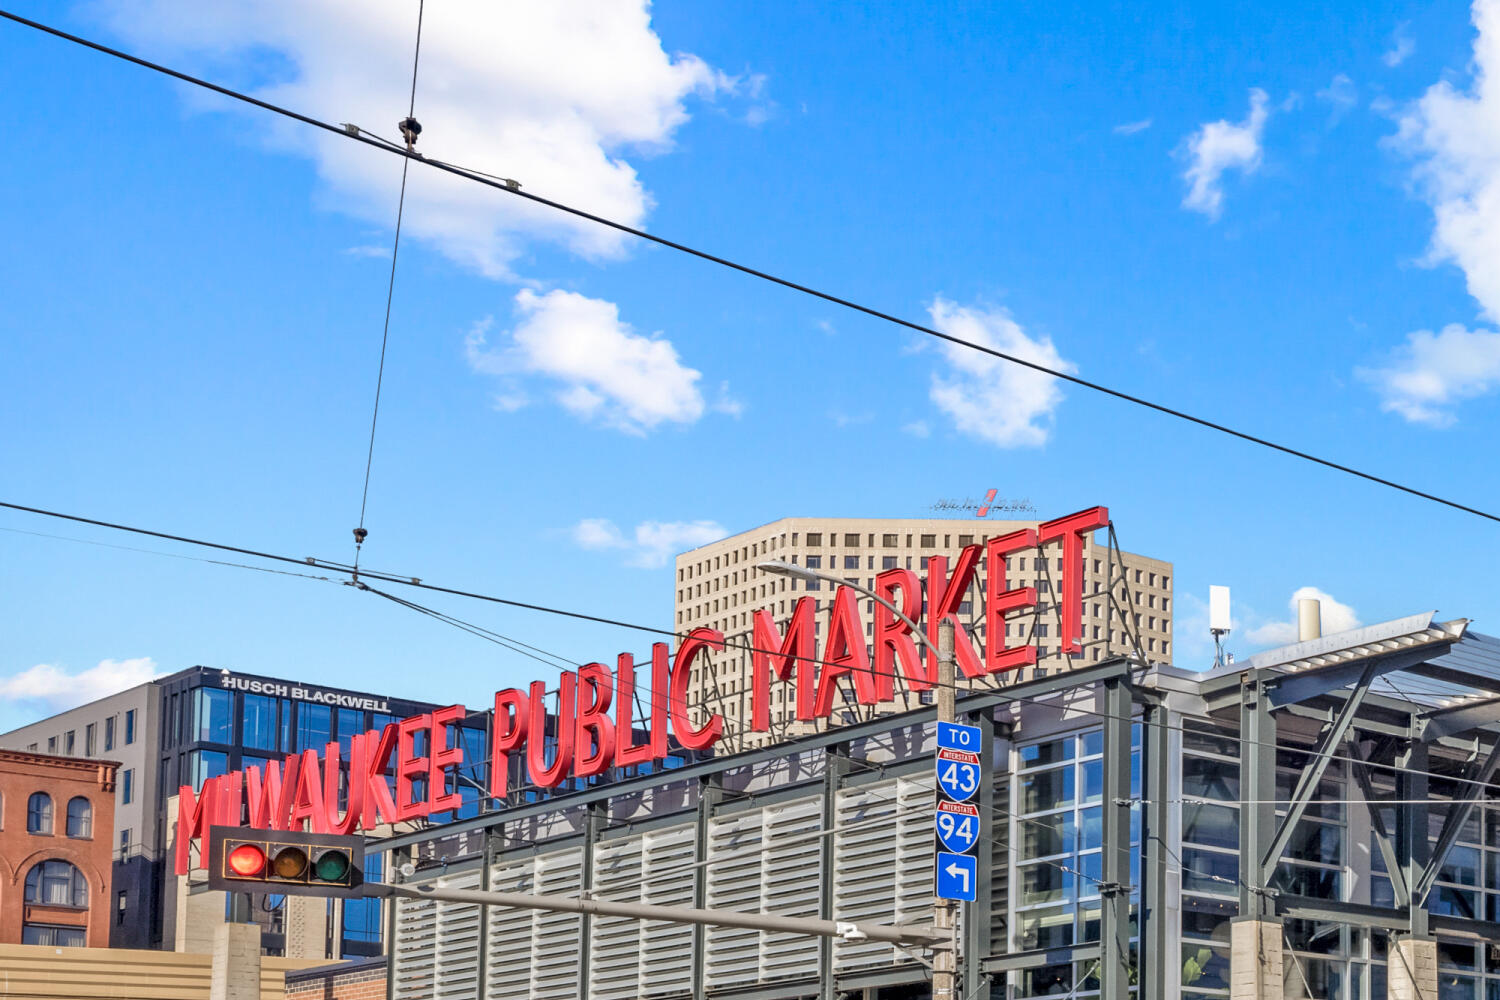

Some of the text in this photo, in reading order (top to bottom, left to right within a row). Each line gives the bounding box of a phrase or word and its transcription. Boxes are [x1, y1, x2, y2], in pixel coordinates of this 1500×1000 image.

[490, 627, 724, 799] PUBLIC
[751, 505, 1109, 733] MARKET
[222, 676, 392, 713] HUSCH BLACKWELL
[949, 728, 970, 745] TO
[943, 751, 975, 763] INTERSTATE
[941, 763, 976, 793] 43
[942, 802, 974, 815] INTERSTATE
[938, 813, 973, 844] 94
